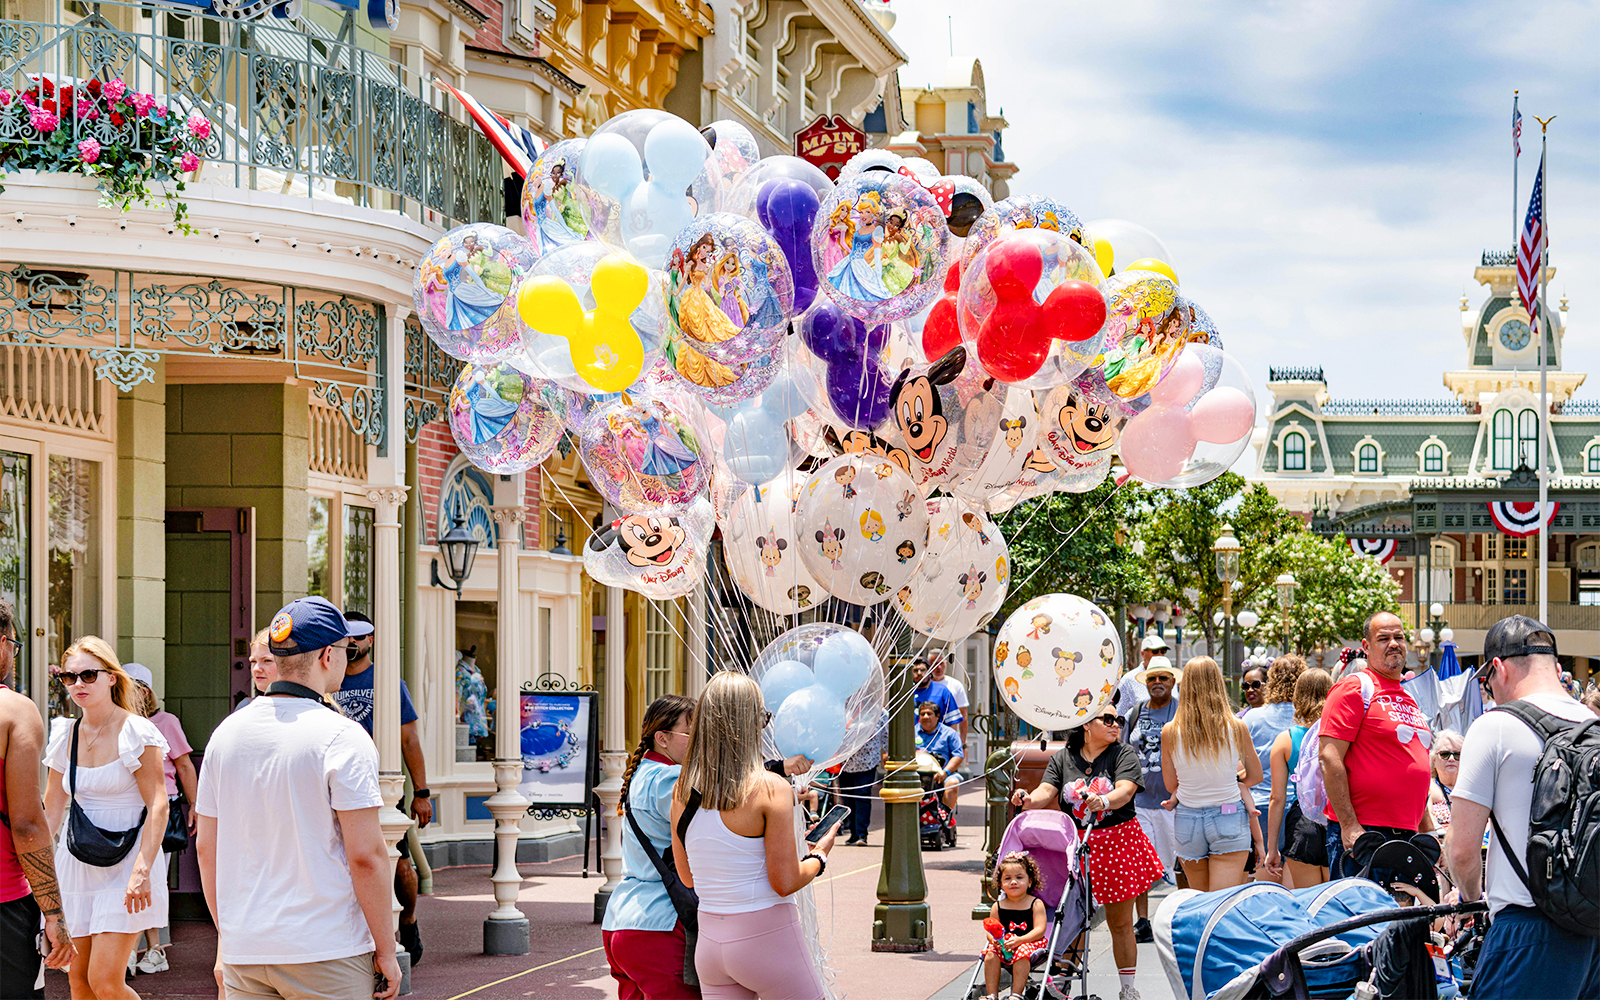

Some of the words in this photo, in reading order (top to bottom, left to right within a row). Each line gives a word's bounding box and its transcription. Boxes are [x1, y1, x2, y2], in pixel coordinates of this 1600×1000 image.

[802, 132, 855, 153] MAIN
[833, 142, 861, 154] ST.
[941, 447, 957, 468] World
